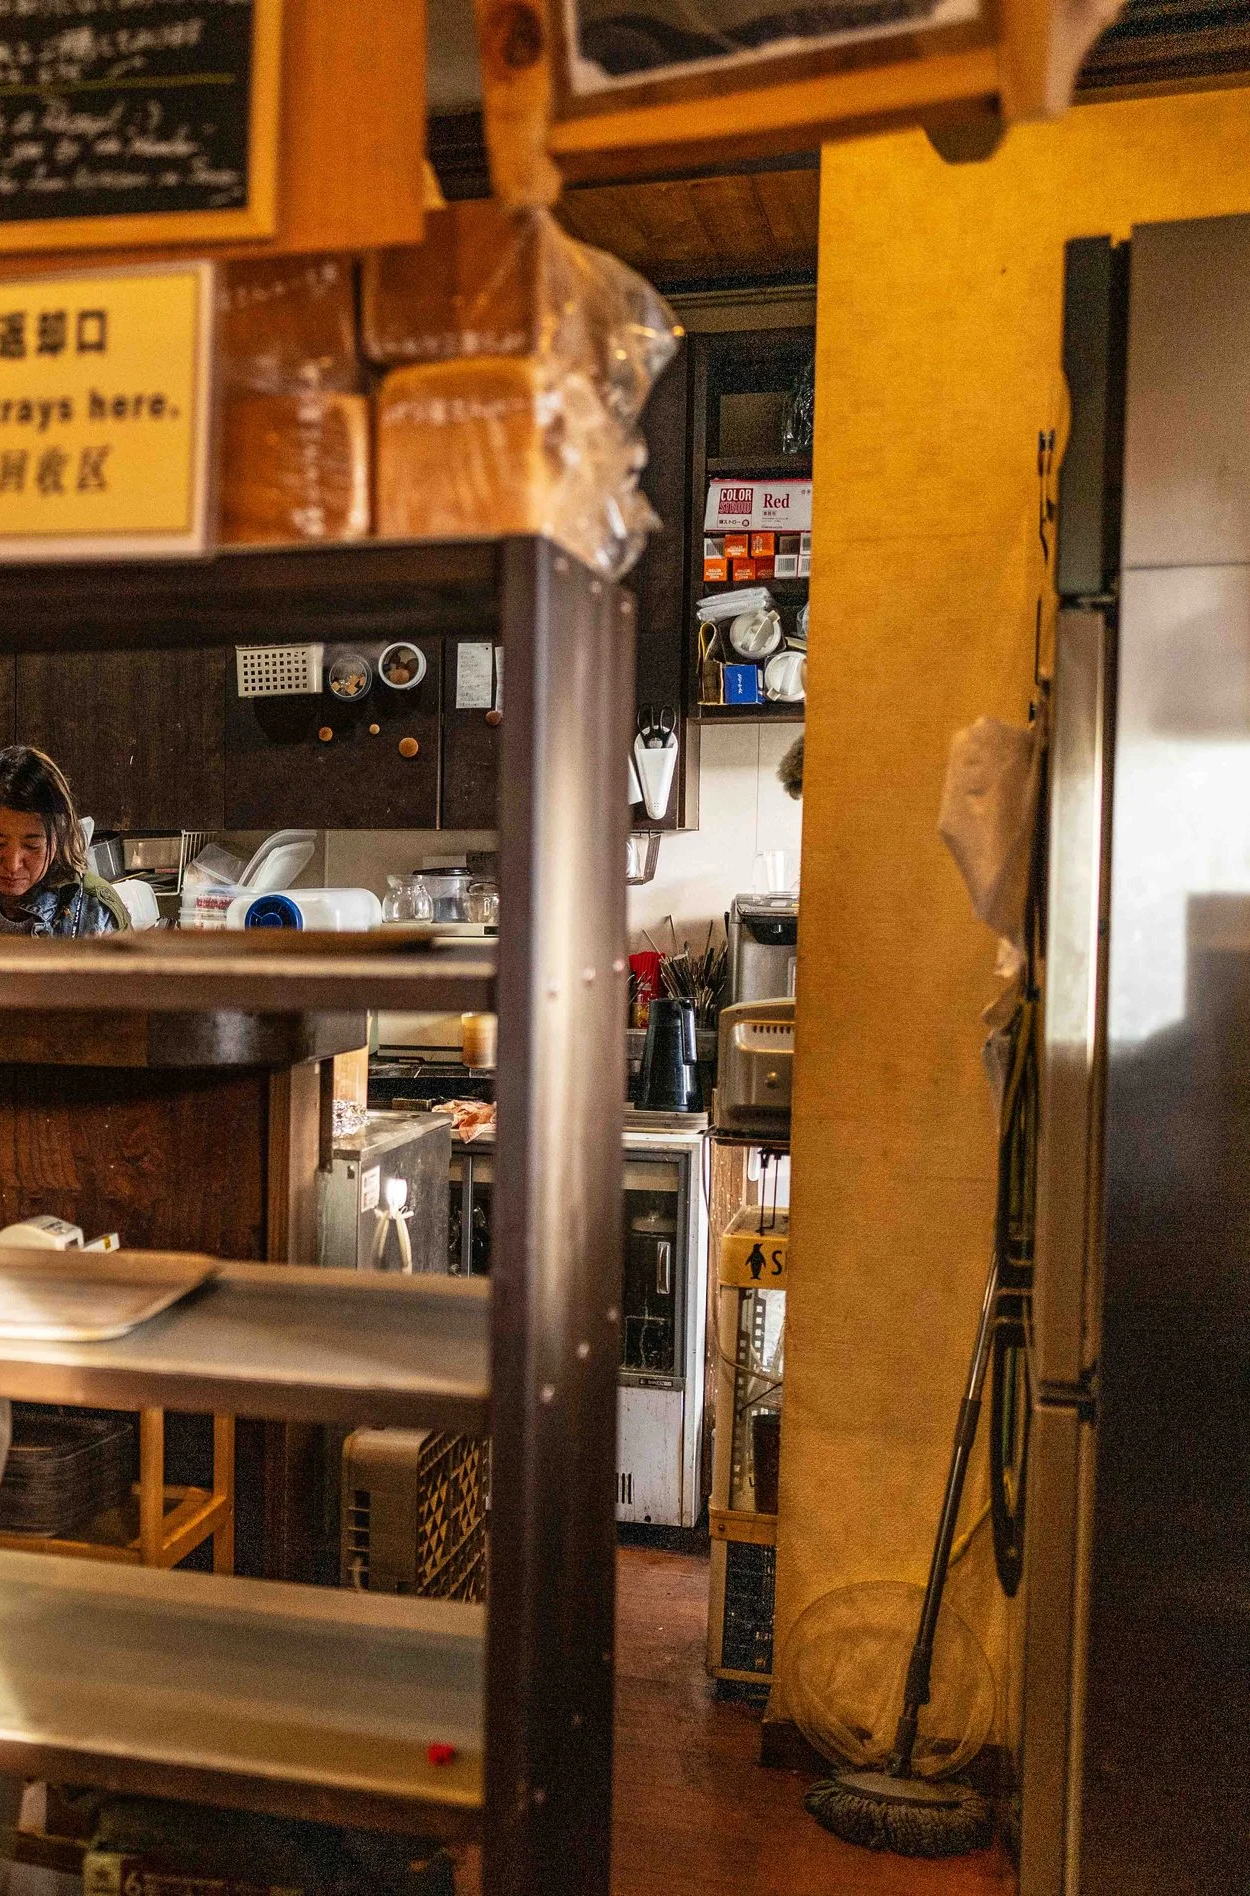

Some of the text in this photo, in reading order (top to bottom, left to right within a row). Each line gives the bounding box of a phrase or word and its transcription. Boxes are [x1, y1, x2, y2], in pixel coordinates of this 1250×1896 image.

[87, 385, 180, 421] here.
[720, 489, 753, 501] COLOR
[763, 493, 790, 509] Red
[719, 501, 752, 514] STRAW
[771, 1249, 783, 1276] S
